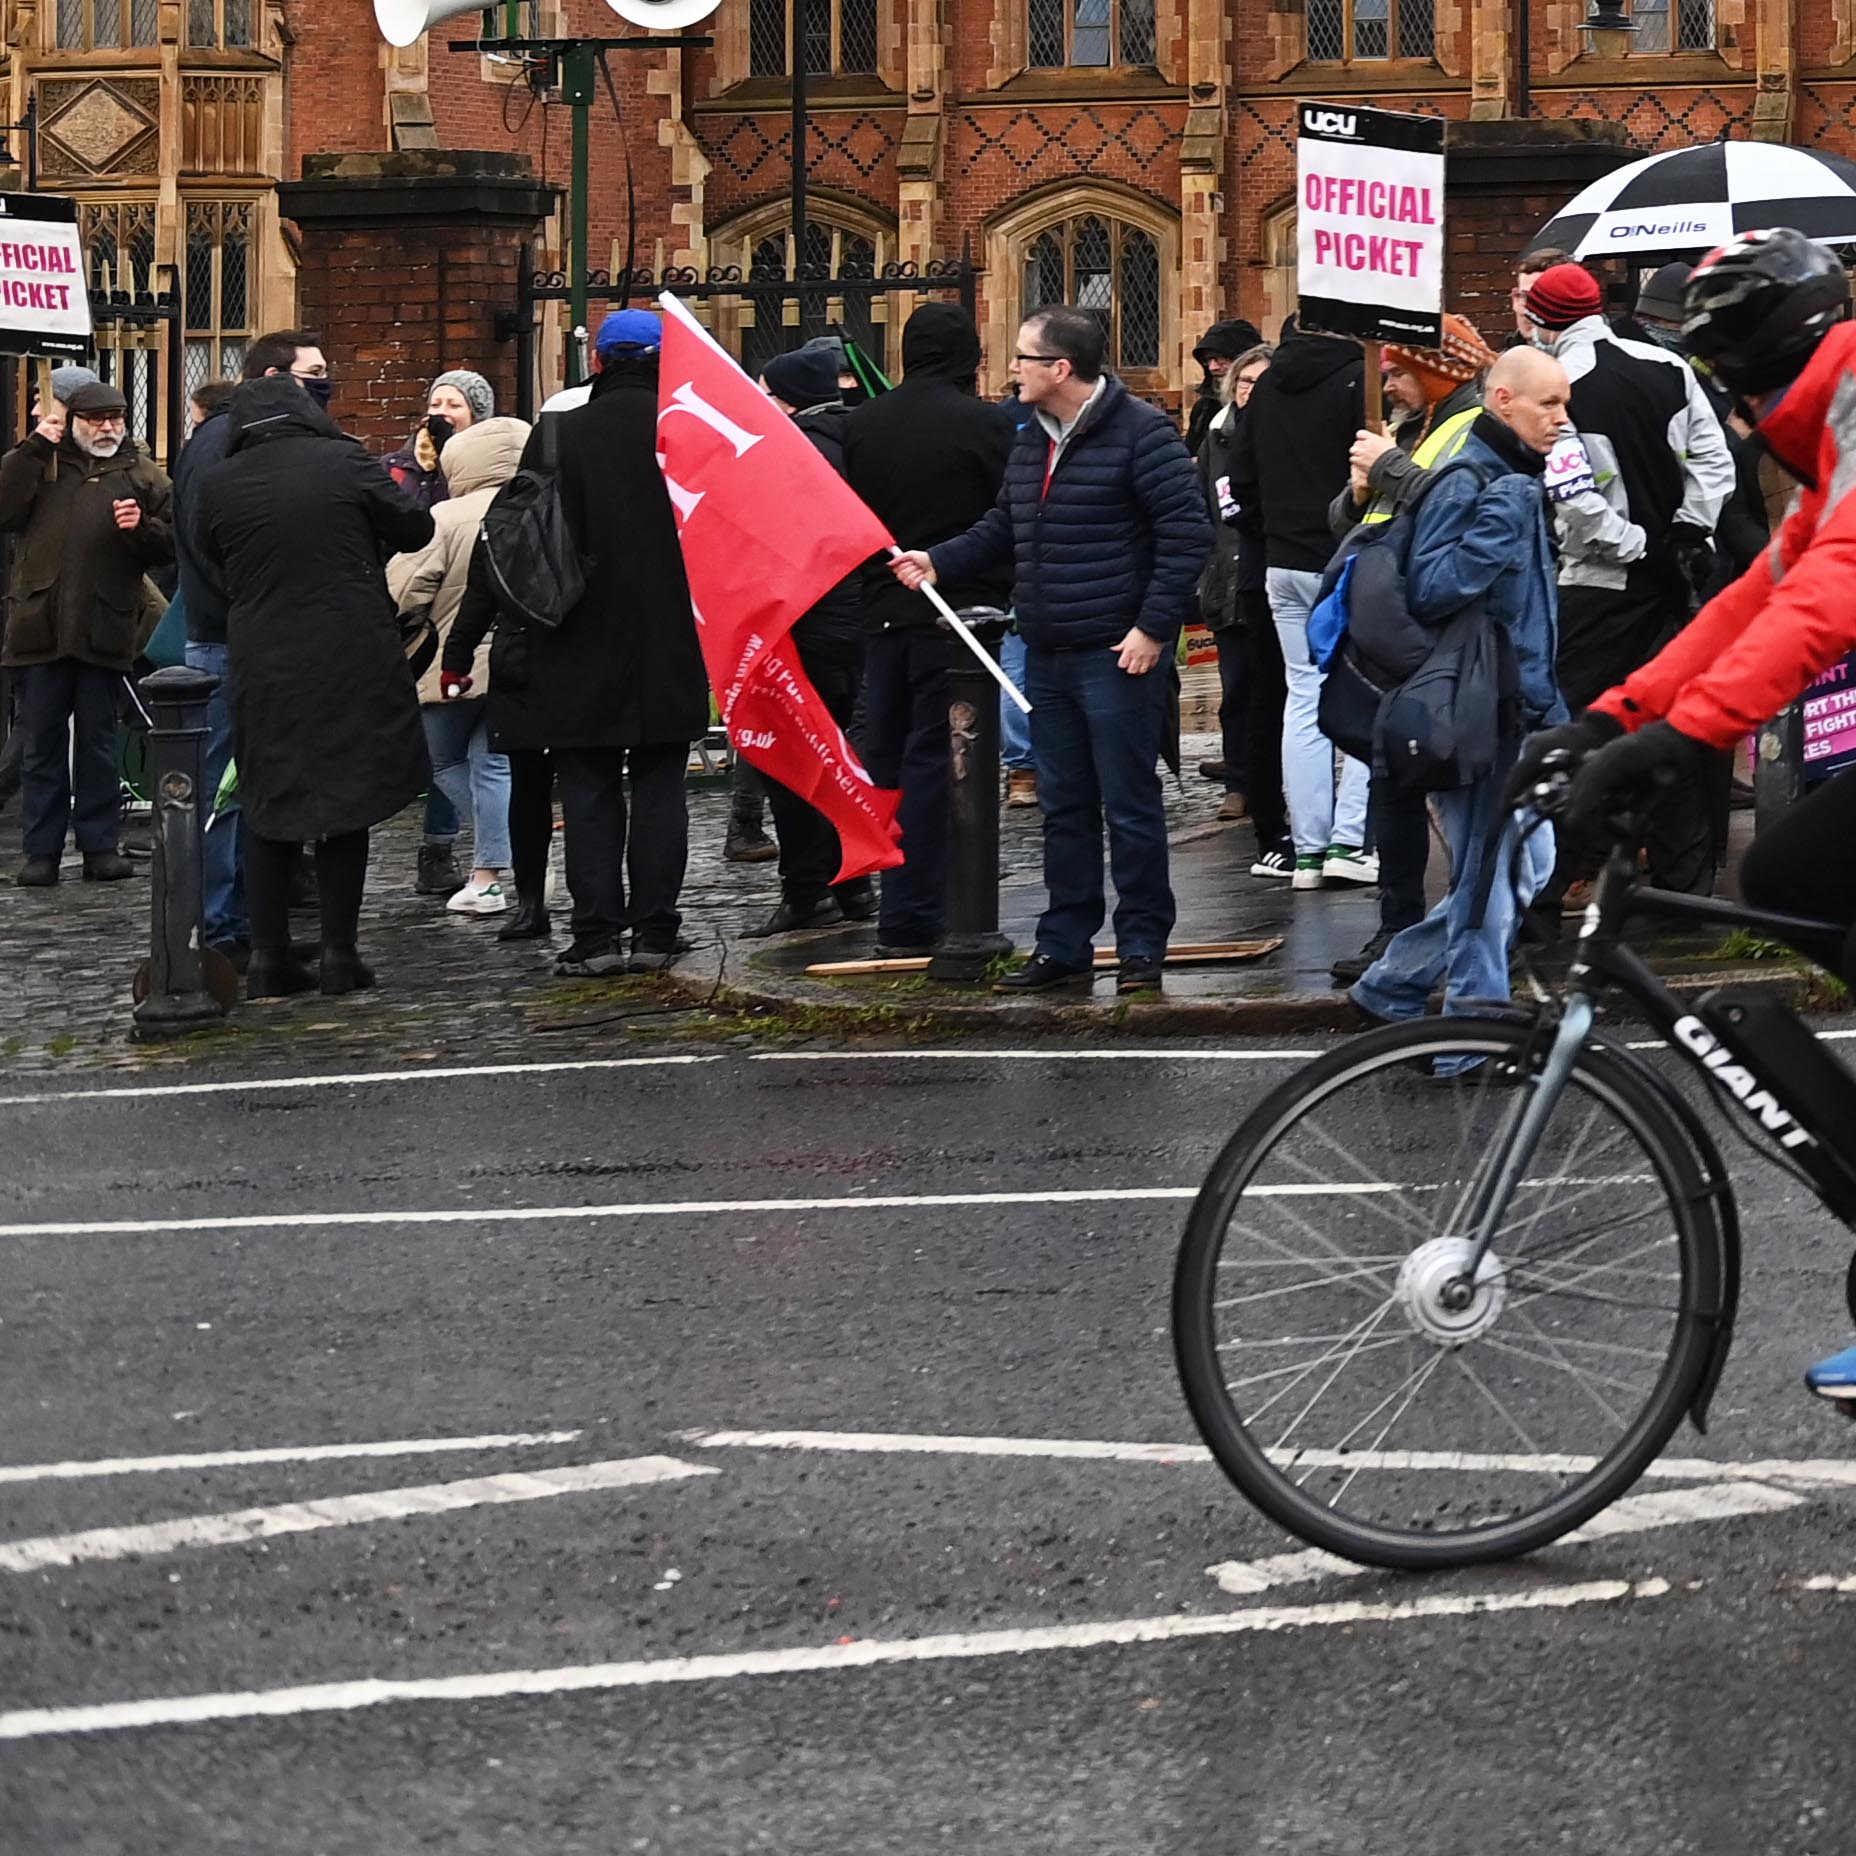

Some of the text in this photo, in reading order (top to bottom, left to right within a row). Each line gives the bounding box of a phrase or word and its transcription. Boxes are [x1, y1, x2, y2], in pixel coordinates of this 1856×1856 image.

[1305, 173, 1435, 224] OFFICIAL
[0, 242, 76, 273] FICIAL
[1314, 229, 1424, 277] PICKET
[0, 280, 70, 310] ICKET
[1673, 1015, 1819, 1149] GIANT
